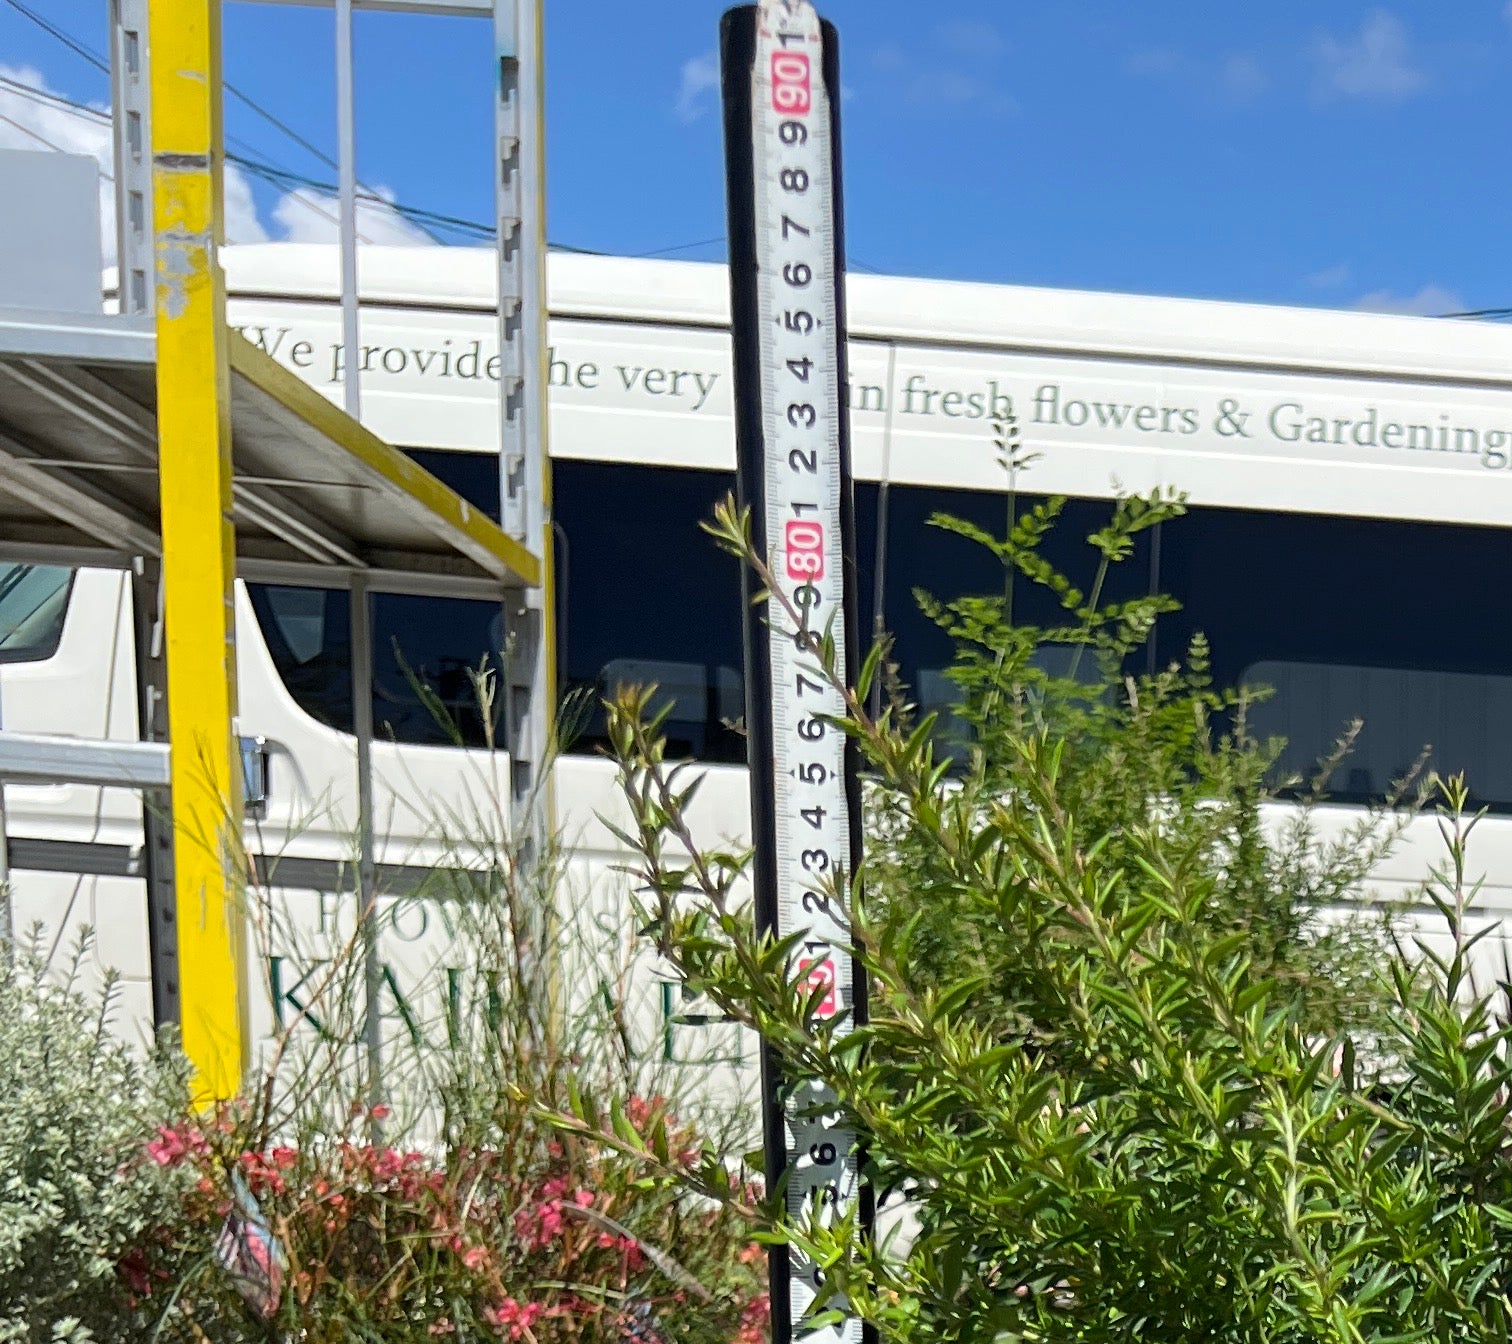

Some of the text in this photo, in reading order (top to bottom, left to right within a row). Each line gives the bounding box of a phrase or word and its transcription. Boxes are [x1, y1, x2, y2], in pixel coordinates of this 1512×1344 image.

[777, 32, 804, 48] 1
[775, 58, 808, 106] 90
[779, 120, 807, 144] 9
[780, 169, 808, 192] 8
[781, 215, 809, 238] 7
[783, 264, 811, 287] 6
[785, 311, 813, 333] 5
[786, 357, 813, 381] 4
[236, 326, 313, 367] We
[547, 346, 598, 388] he
[617, 366, 722, 410] very
[900, 375, 1015, 421] fresh
[1030, 384, 1201, 435] flowers
[1213, 399, 1254, 438] &
[787, 404, 816, 427] 3
[789, 449, 816, 473] 2
[791, 502, 817, 516] 1
[789, 528, 821, 572] 80
[794, 585, 821, 609] 9
[796, 674, 823, 697] 7
[798, 717, 825, 740] 6
[799, 763, 826, 785] 5
[801, 806, 826, 829] 4
[802, 849, 828, 872] 3
[803, 892, 829, 913] 2
[805, 940, 830, 955] 1
[810, 1143, 836, 1166] 6
